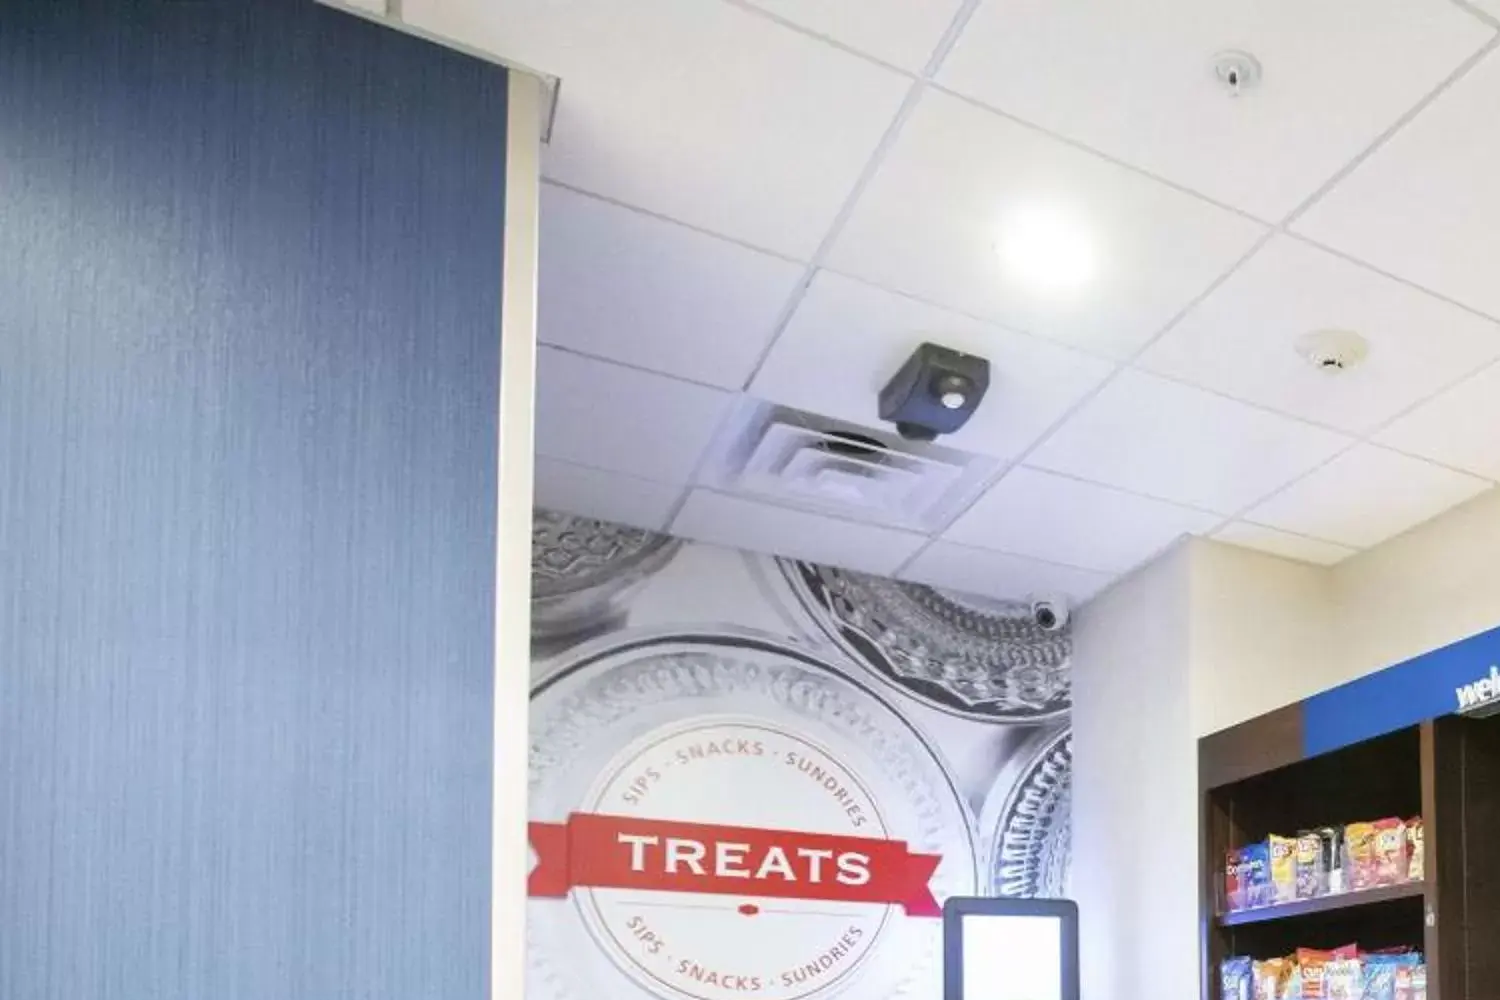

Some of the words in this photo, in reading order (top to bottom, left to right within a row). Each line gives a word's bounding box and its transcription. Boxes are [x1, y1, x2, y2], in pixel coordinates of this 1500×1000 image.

[622, 767, 662, 806] SIPS
[675, 738, 765, 766] SNACKS
[785, 751, 869, 829] SUNDRIES
[617, 831, 872, 886] TREATS
[626, 915, 666, 954] SIPS
[676, 959, 762, 992] SNACKS
[780, 925, 864, 988] SUNDRIES
